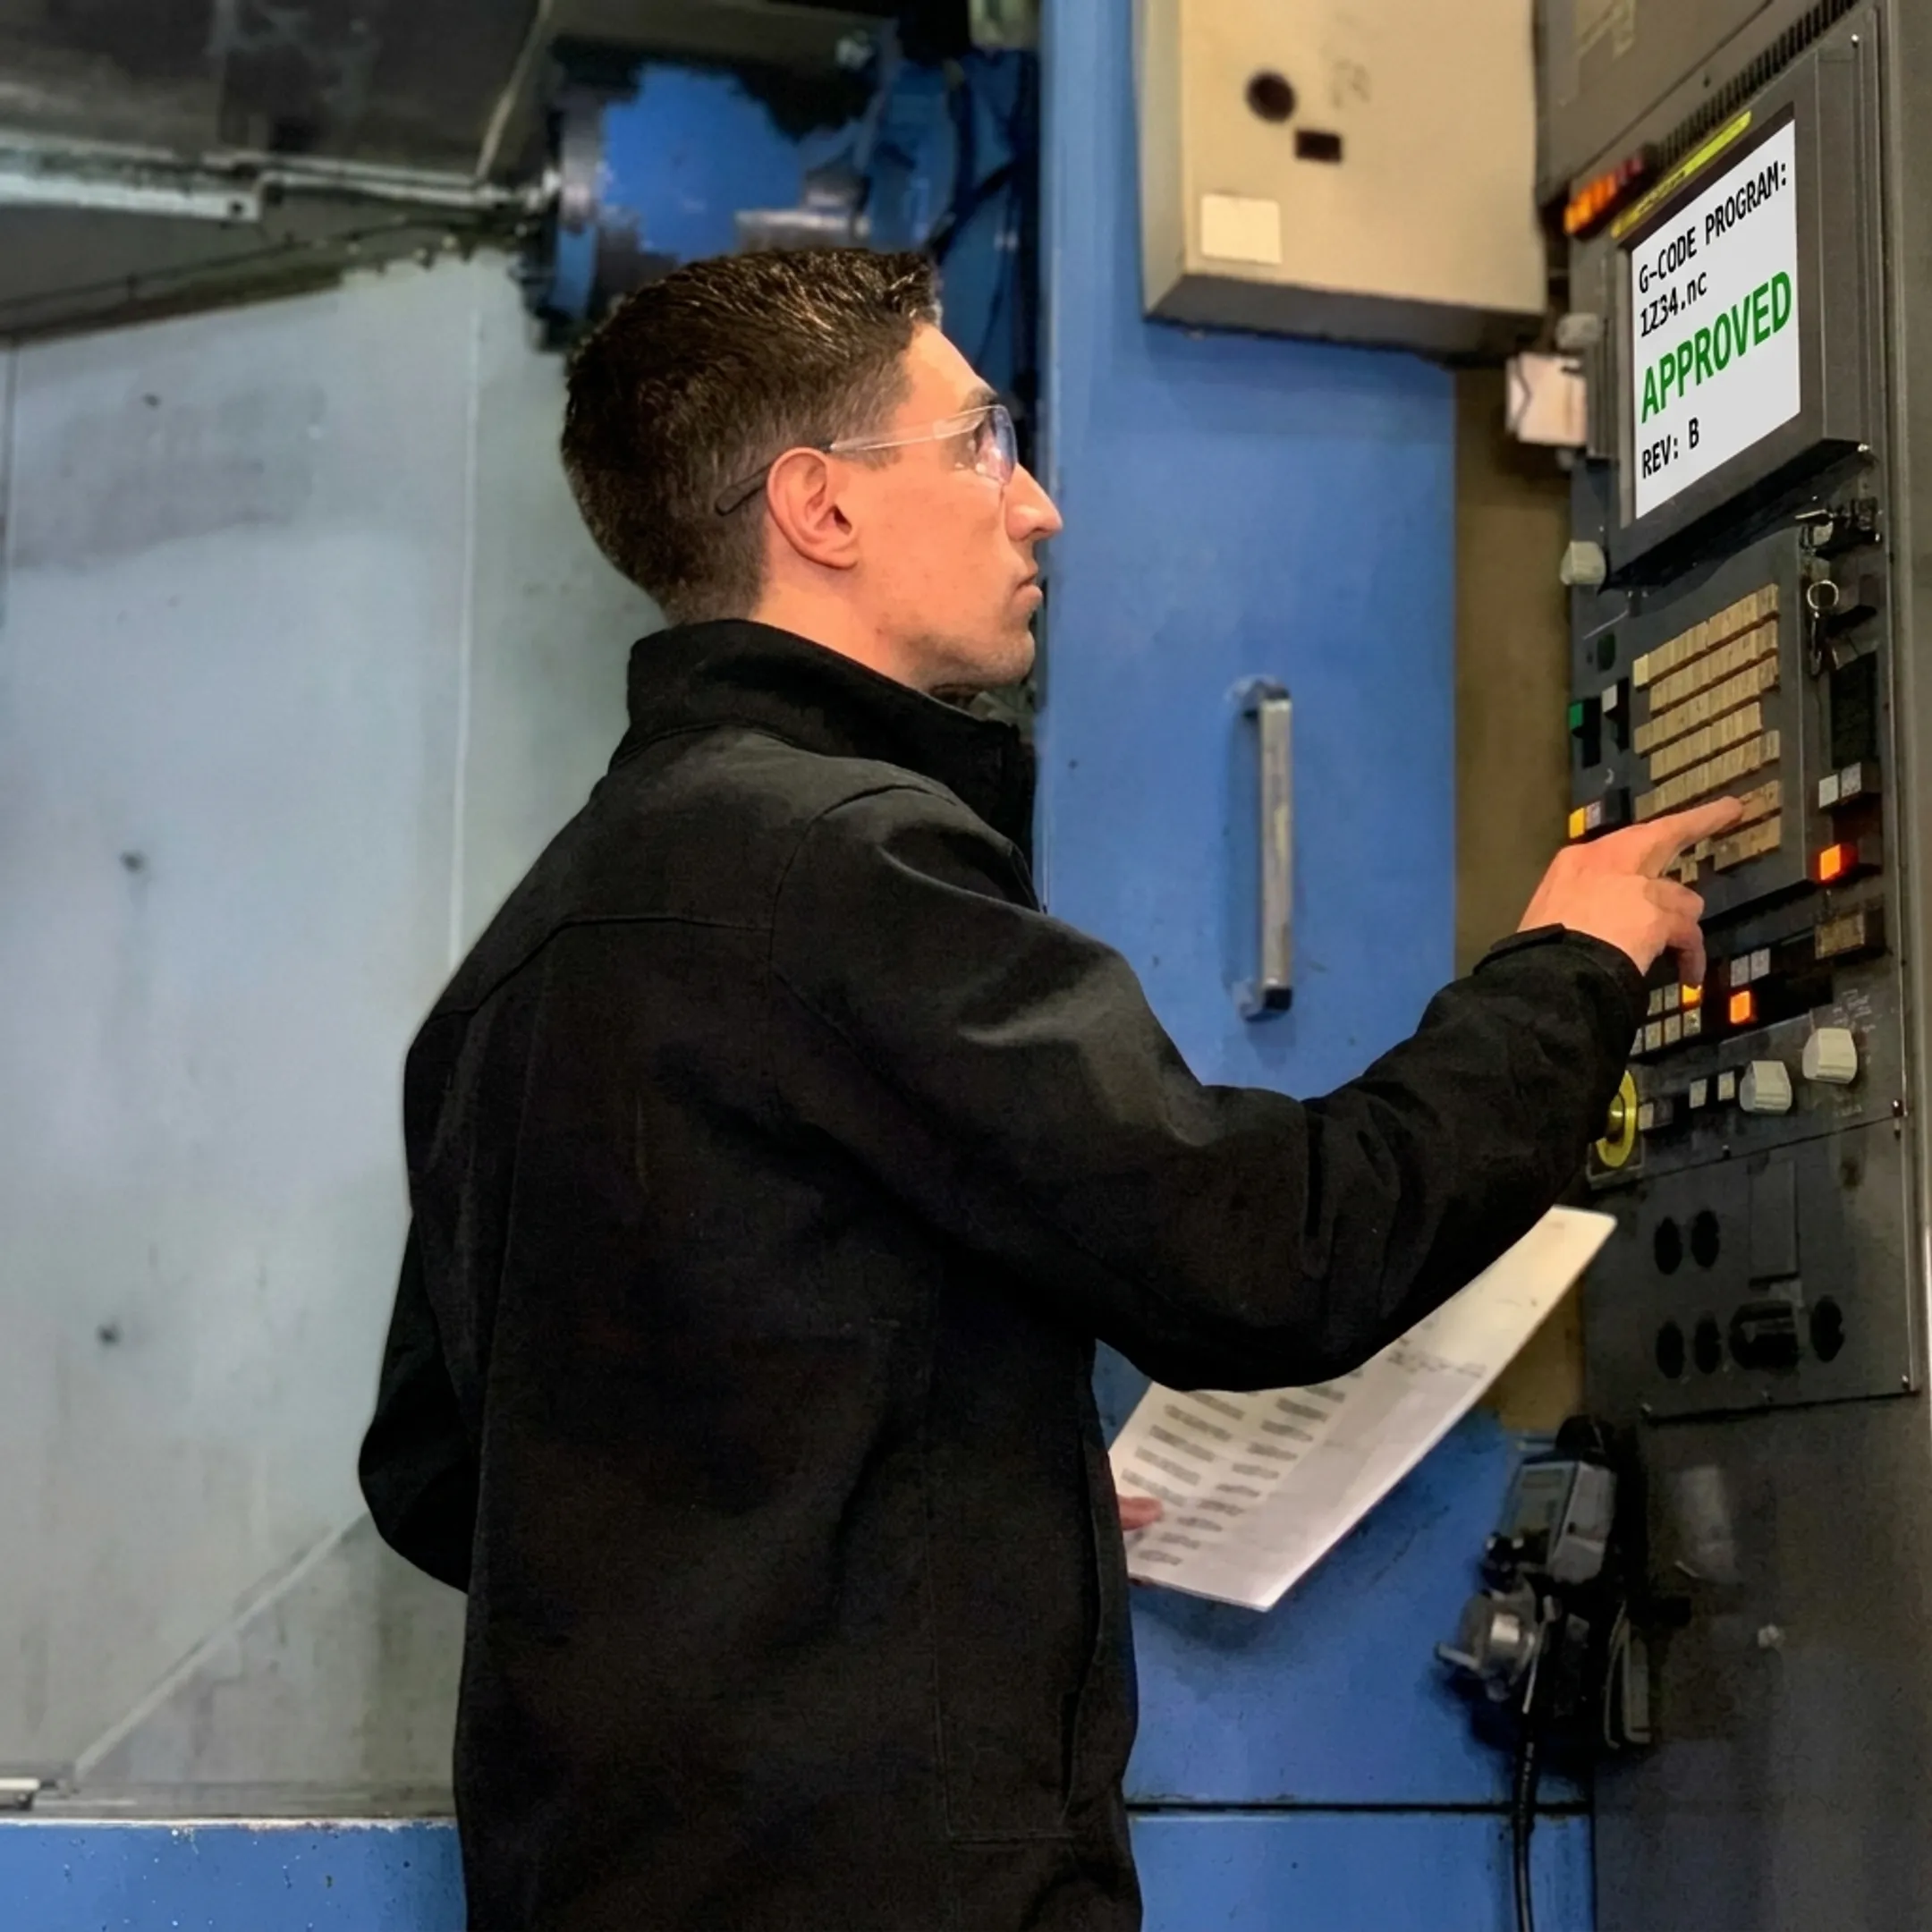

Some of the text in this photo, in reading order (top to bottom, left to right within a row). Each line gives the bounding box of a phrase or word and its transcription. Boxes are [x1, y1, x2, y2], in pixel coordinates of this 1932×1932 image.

[1639, 225, 1698, 294] G-CODE
[1705, 160, 1787, 246] PROGRAM:
[1640, 271, 1707, 338] 1234.nc
[1641, 271, 1792, 424] APPROVED
[1641, 417, 1699, 479] REV: B
